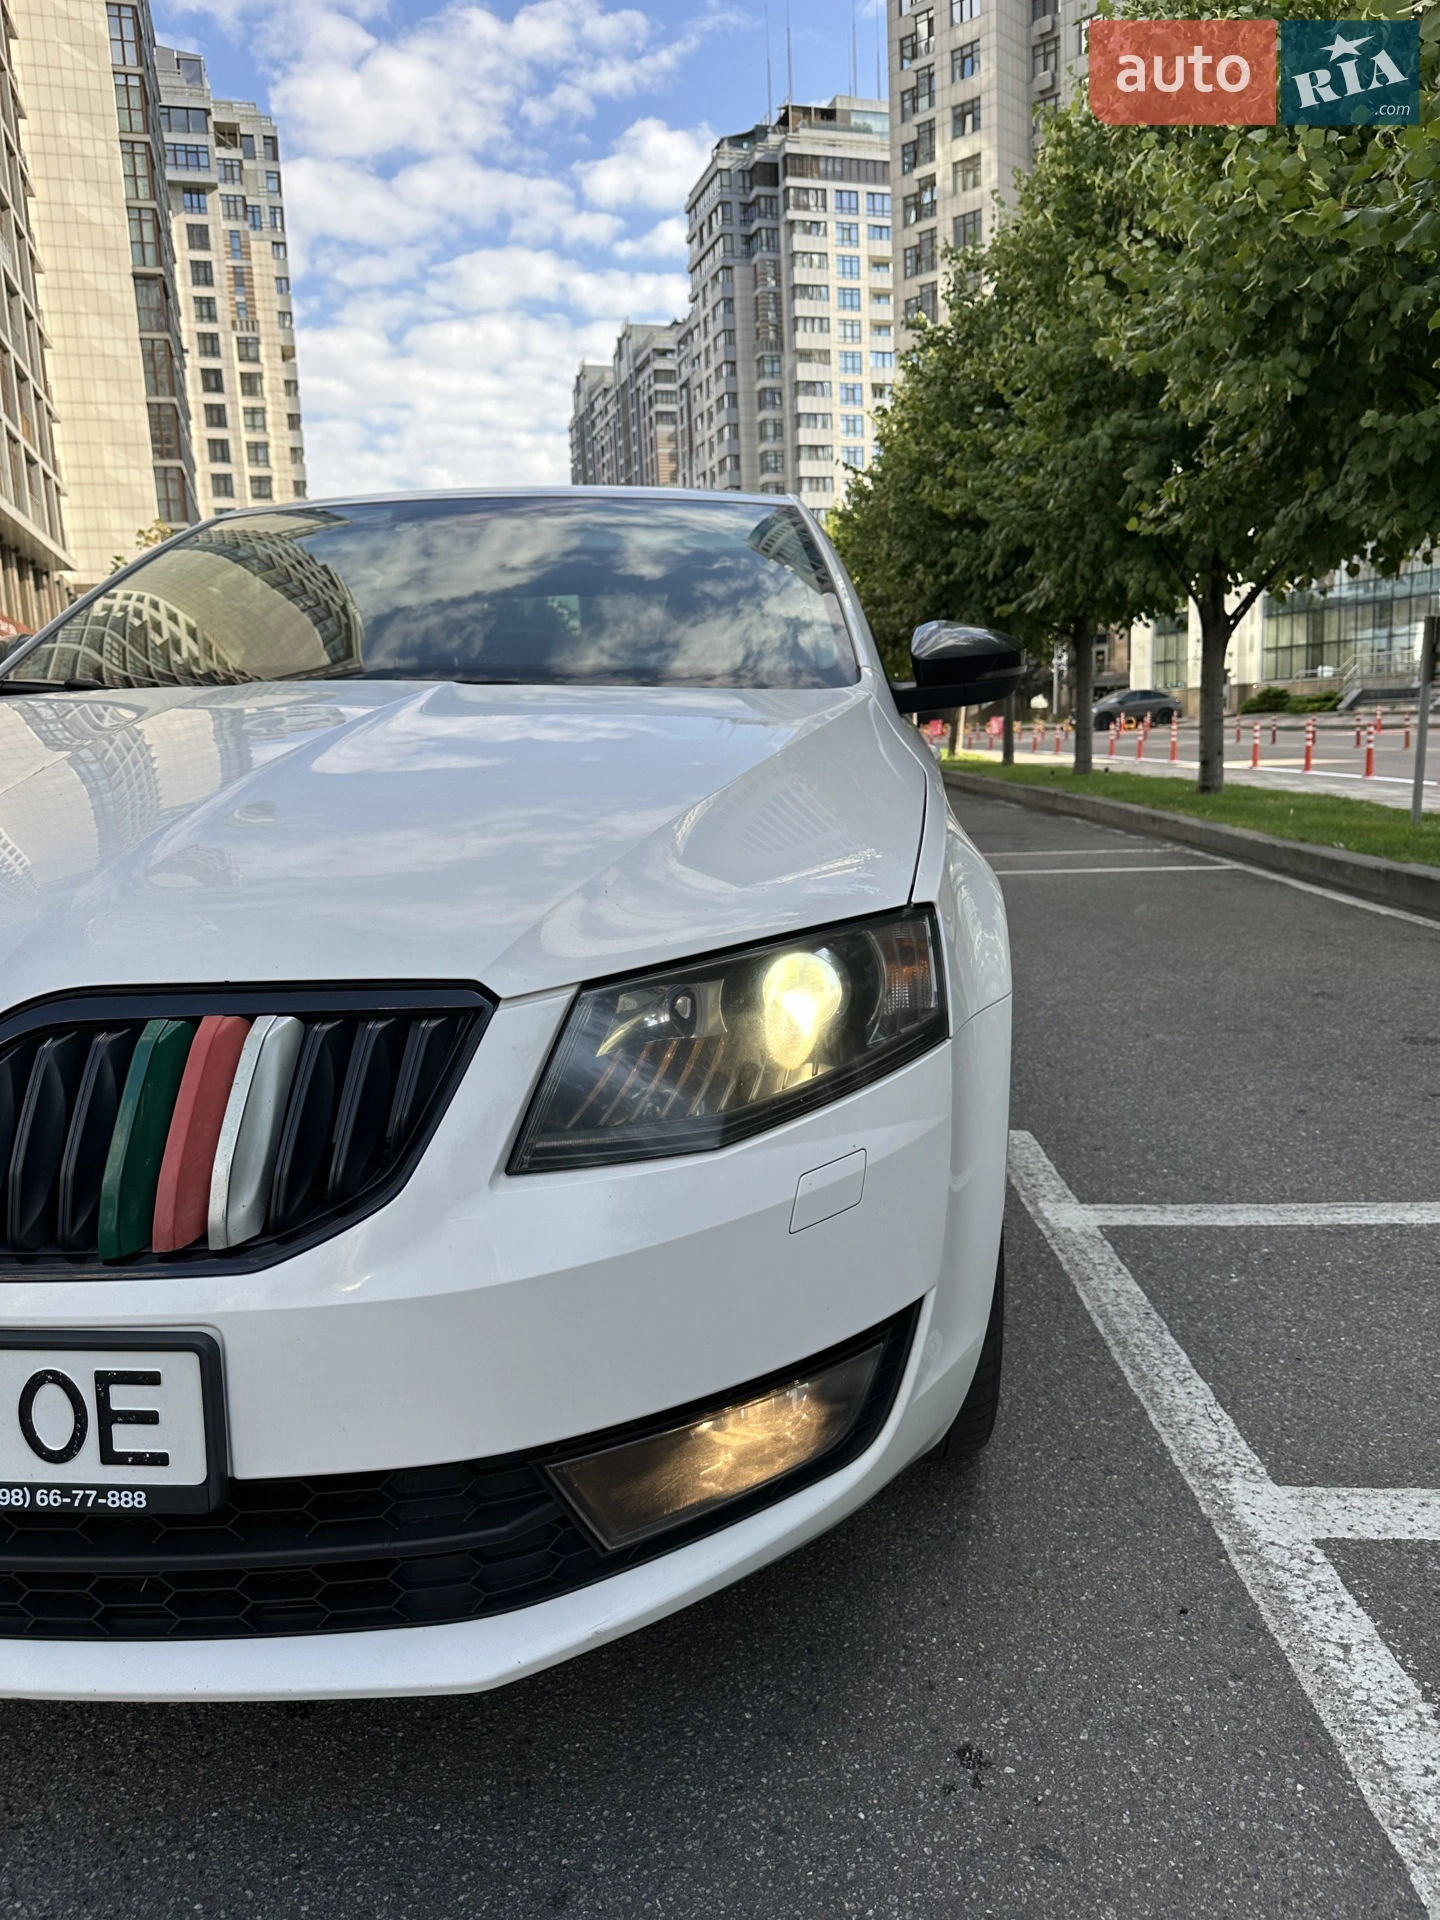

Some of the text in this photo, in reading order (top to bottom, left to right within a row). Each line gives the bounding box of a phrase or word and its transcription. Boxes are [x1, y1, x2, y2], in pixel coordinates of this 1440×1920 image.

[18, 1368, 170, 1466] OE
[0, 1486, 147, 1508] 98) 66-77-888
